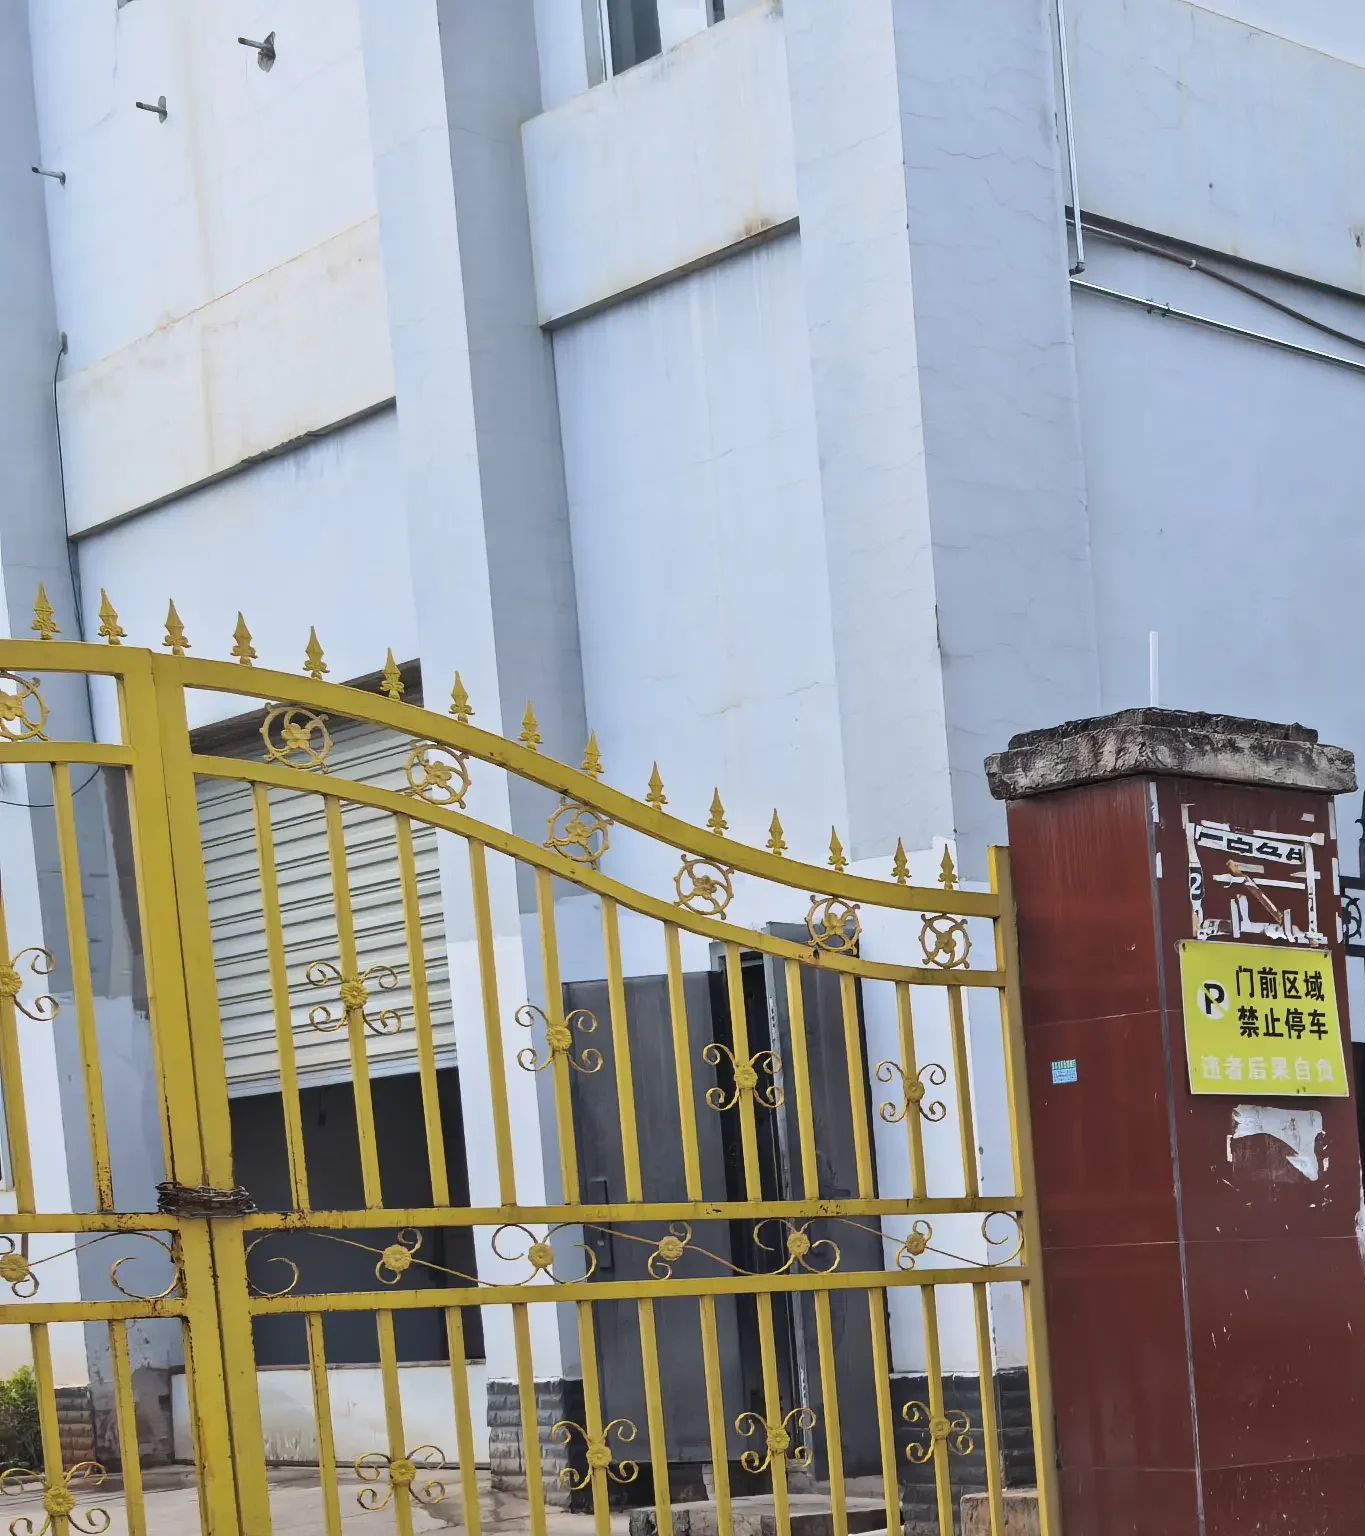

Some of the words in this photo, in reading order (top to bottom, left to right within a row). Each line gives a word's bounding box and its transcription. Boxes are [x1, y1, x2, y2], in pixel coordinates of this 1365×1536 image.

[1235, 965, 1325, 1002] 门前区域
[1237, 1005, 1329, 1040] 禁止停车
[1201, 1055, 1334, 1083] 违者后果自负
